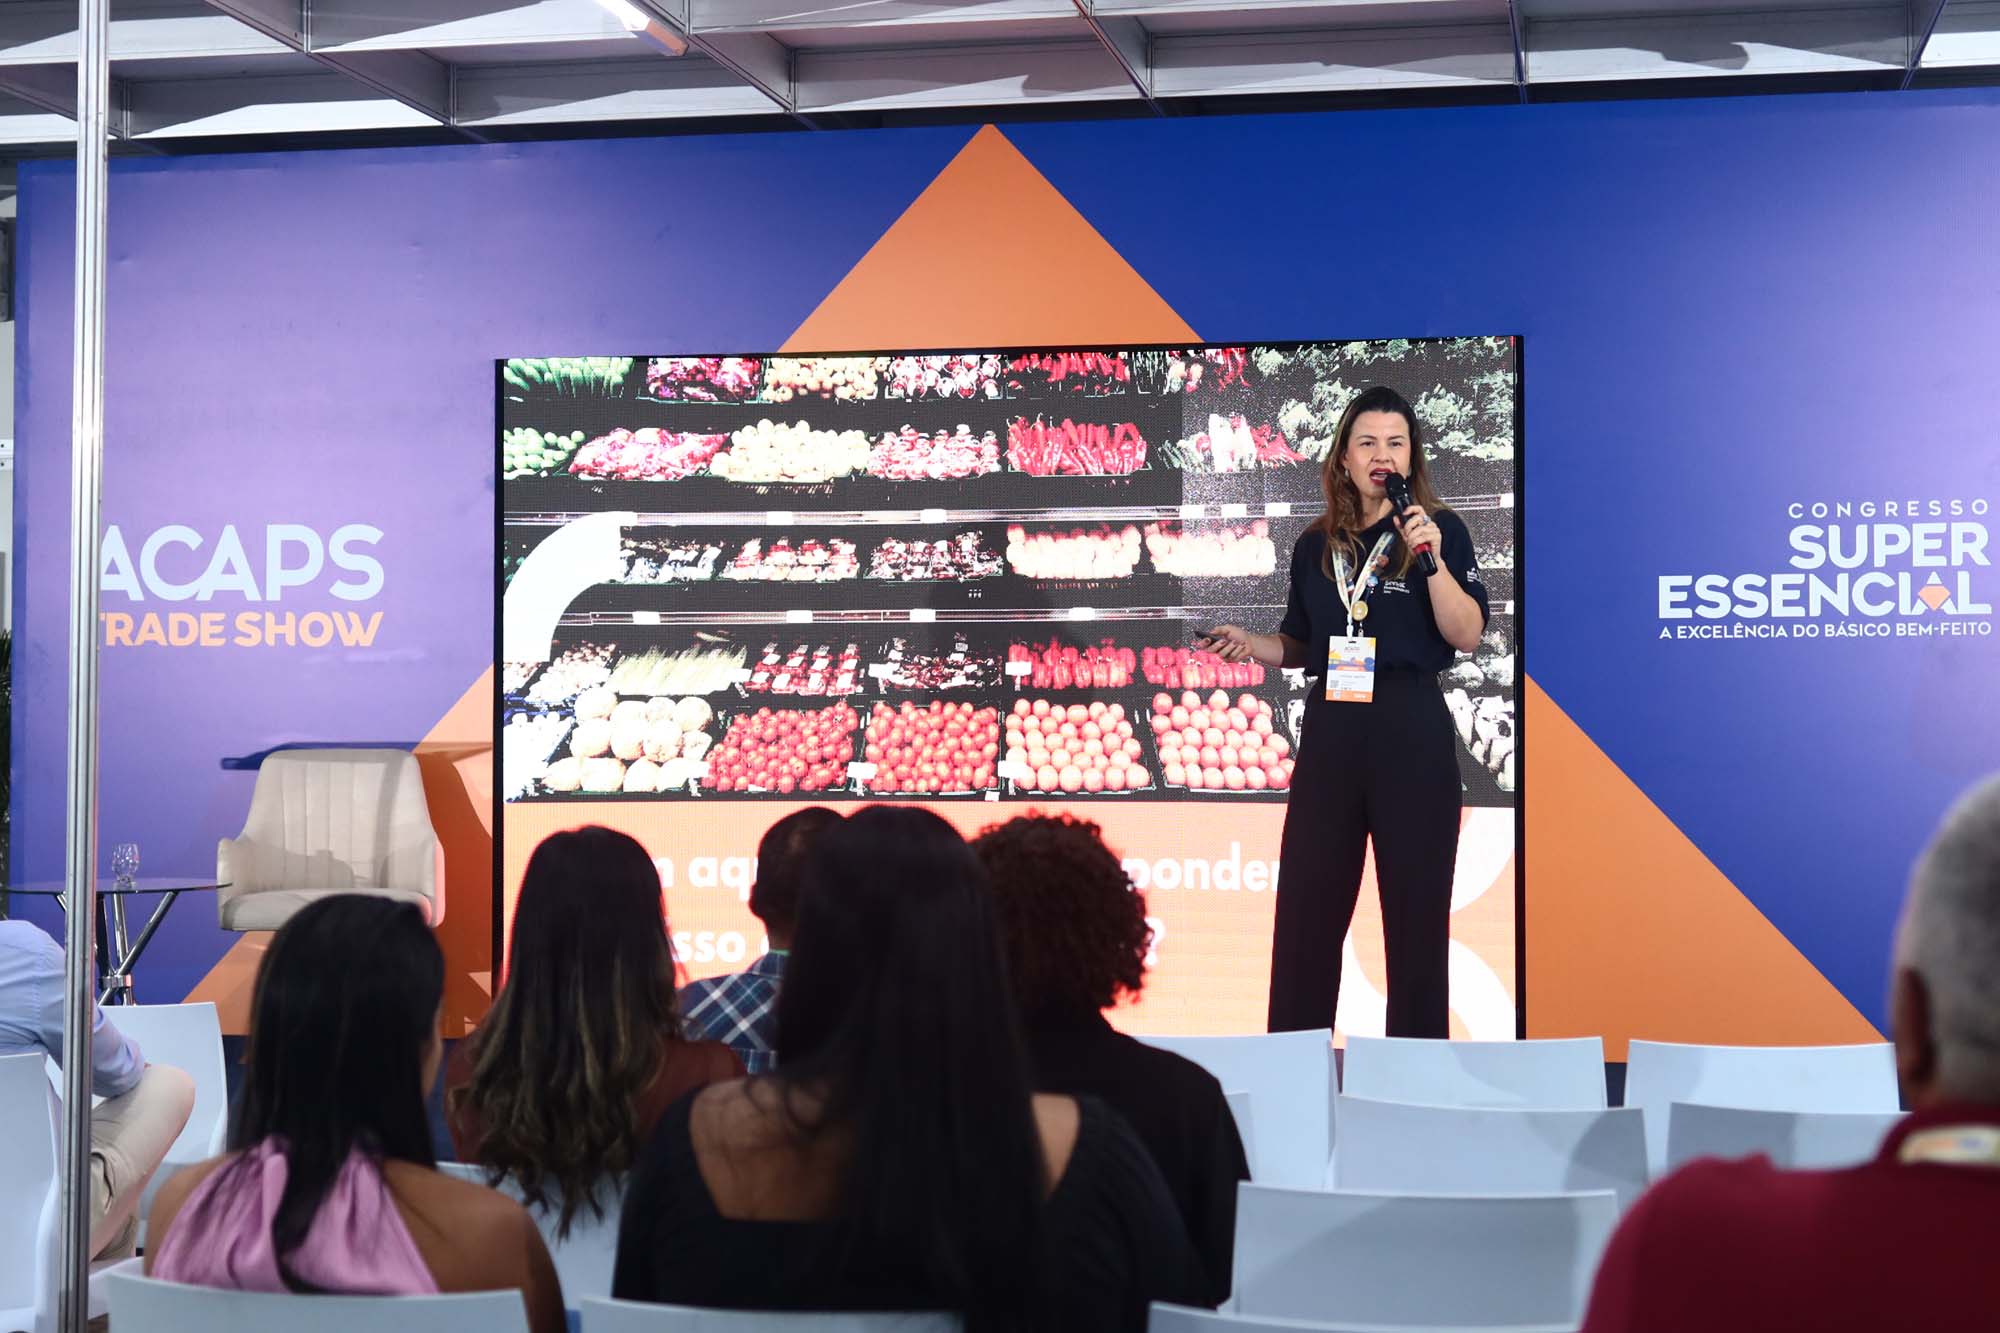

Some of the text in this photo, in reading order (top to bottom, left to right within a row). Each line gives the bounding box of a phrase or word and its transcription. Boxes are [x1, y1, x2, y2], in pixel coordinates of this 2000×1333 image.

[1788, 498, 1989, 519] CONGRESSO
[100, 523, 385, 601] ACAPS
[1788, 522, 1992, 570] SUPER
[1658, 570, 1993, 619] ESSENCIAL
[98, 611, 384, 647] RADE SHOW
[1659, 621, 1992, 639] A EXCELÊNCIA DO BÁSICO BEM-FEITO
[664, 916, 746, 963] sso
